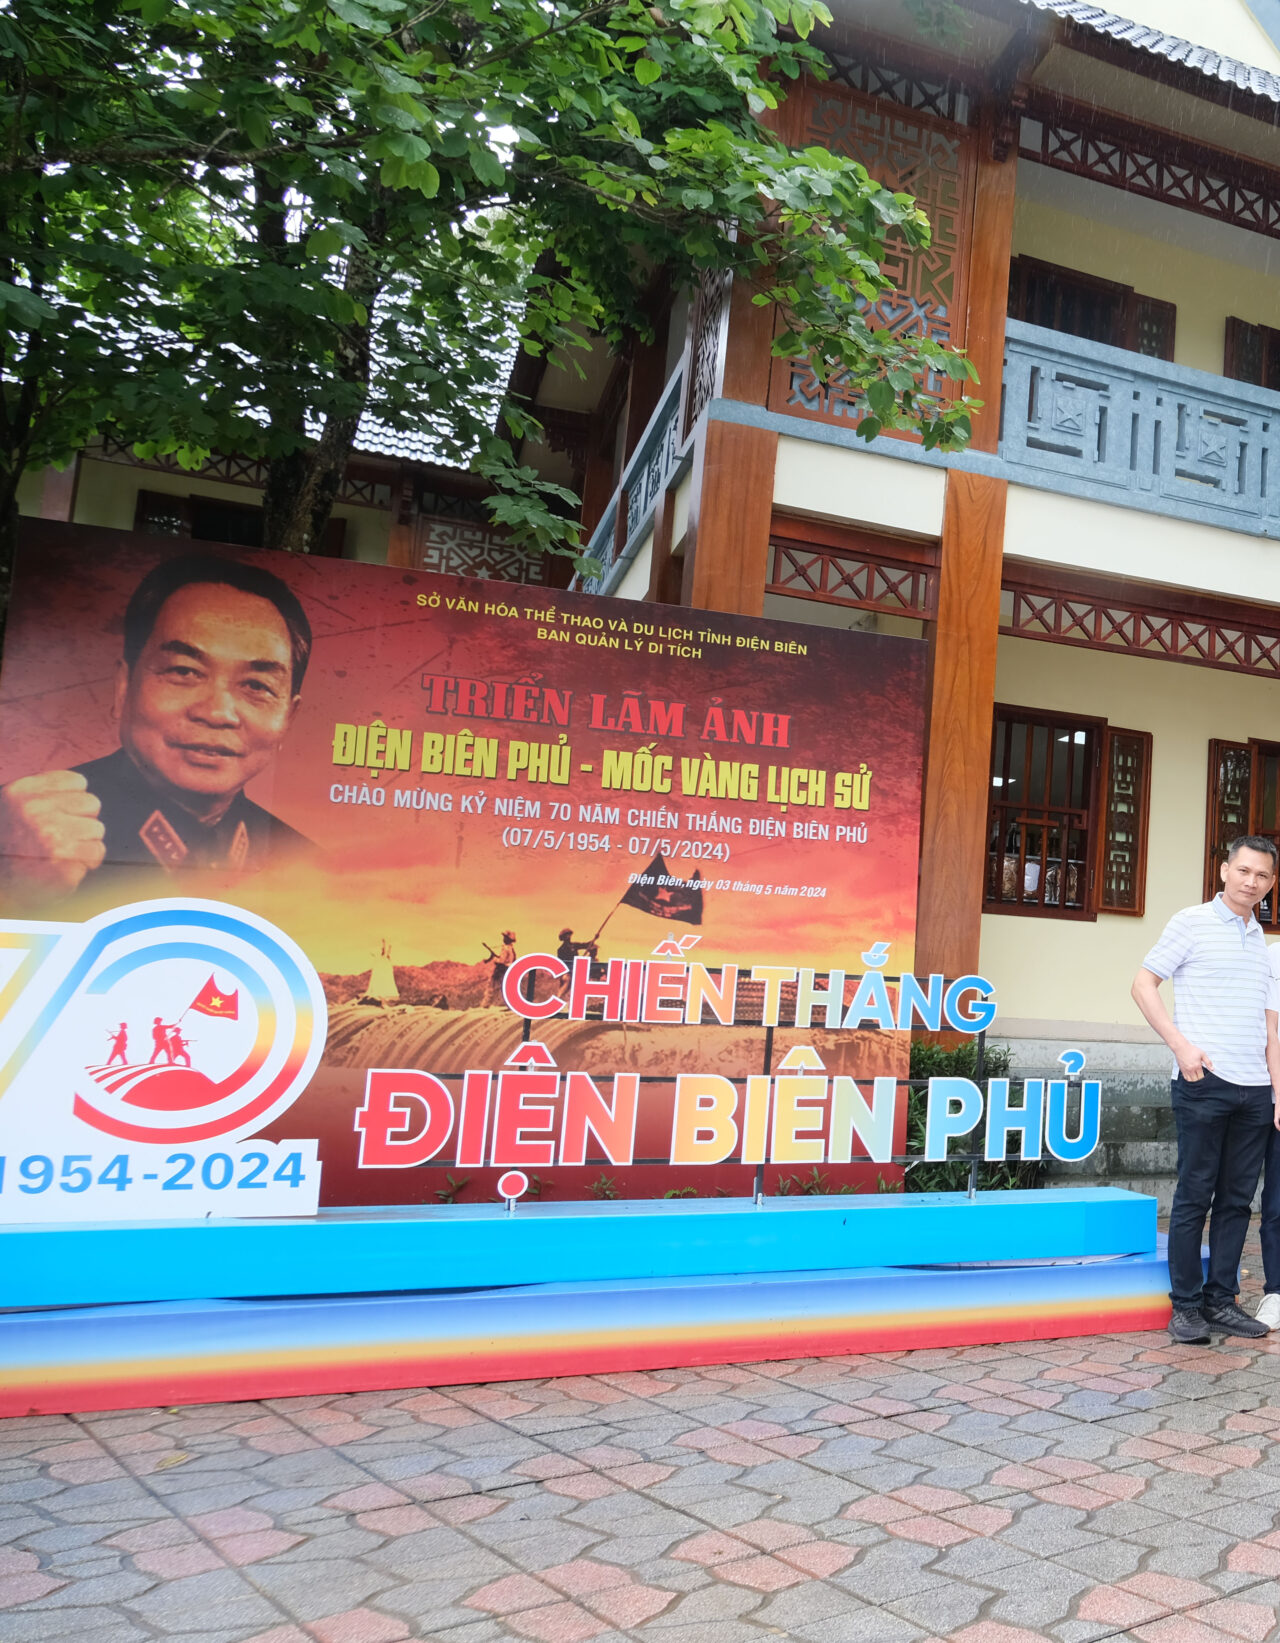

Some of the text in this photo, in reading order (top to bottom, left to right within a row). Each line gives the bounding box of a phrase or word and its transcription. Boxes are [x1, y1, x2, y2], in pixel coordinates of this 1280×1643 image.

[416, 591, 808, 656] SỞ VĂN HÓA THỂ THAO VÀ DU LỊCH TỈNH ĐIỆN BIÊN
[537, 627, 702, 659] BAN QUẢN LÝ DI TÍCH
[422, 671, 792, 748] TRIỂN LÃM ẢNH
[332, 719, 413, 778] ĐIỆN
[421, 728, 499, 779] BIÊN
[507, 733, 572, 785] PHỦ
[601, 742, 673, 794] MỐC
[681, 752, 760, 801] VÀNG
[767, 765, 827, 813] LỊCH
[834, 763, 872, 811] SỬ
[329, 782, 868, 844] CHÀO MỪNG KỶ NIỆM 70 NĂM CHIẾN THẮNG ĐIỆN BIÊN PHỦ
[502, 826, 611, 852] (07/5/1954
[628, 836, 730, 862] 07/5/2024)
[627, 873, 655, 888] Điện
[715, 879, 730, 891] 03
[732, 881, 764, 895] tháng
[764, 885, 773, 896] 5
[774, 885, 799, 896] năm
[799, 886, 827, 898] 2024
[502, 934, 999, 1034] CHIẾN THẮNG
[354, 1041, 1103, 1199] ĐIỆN BIÊN PHỦ
